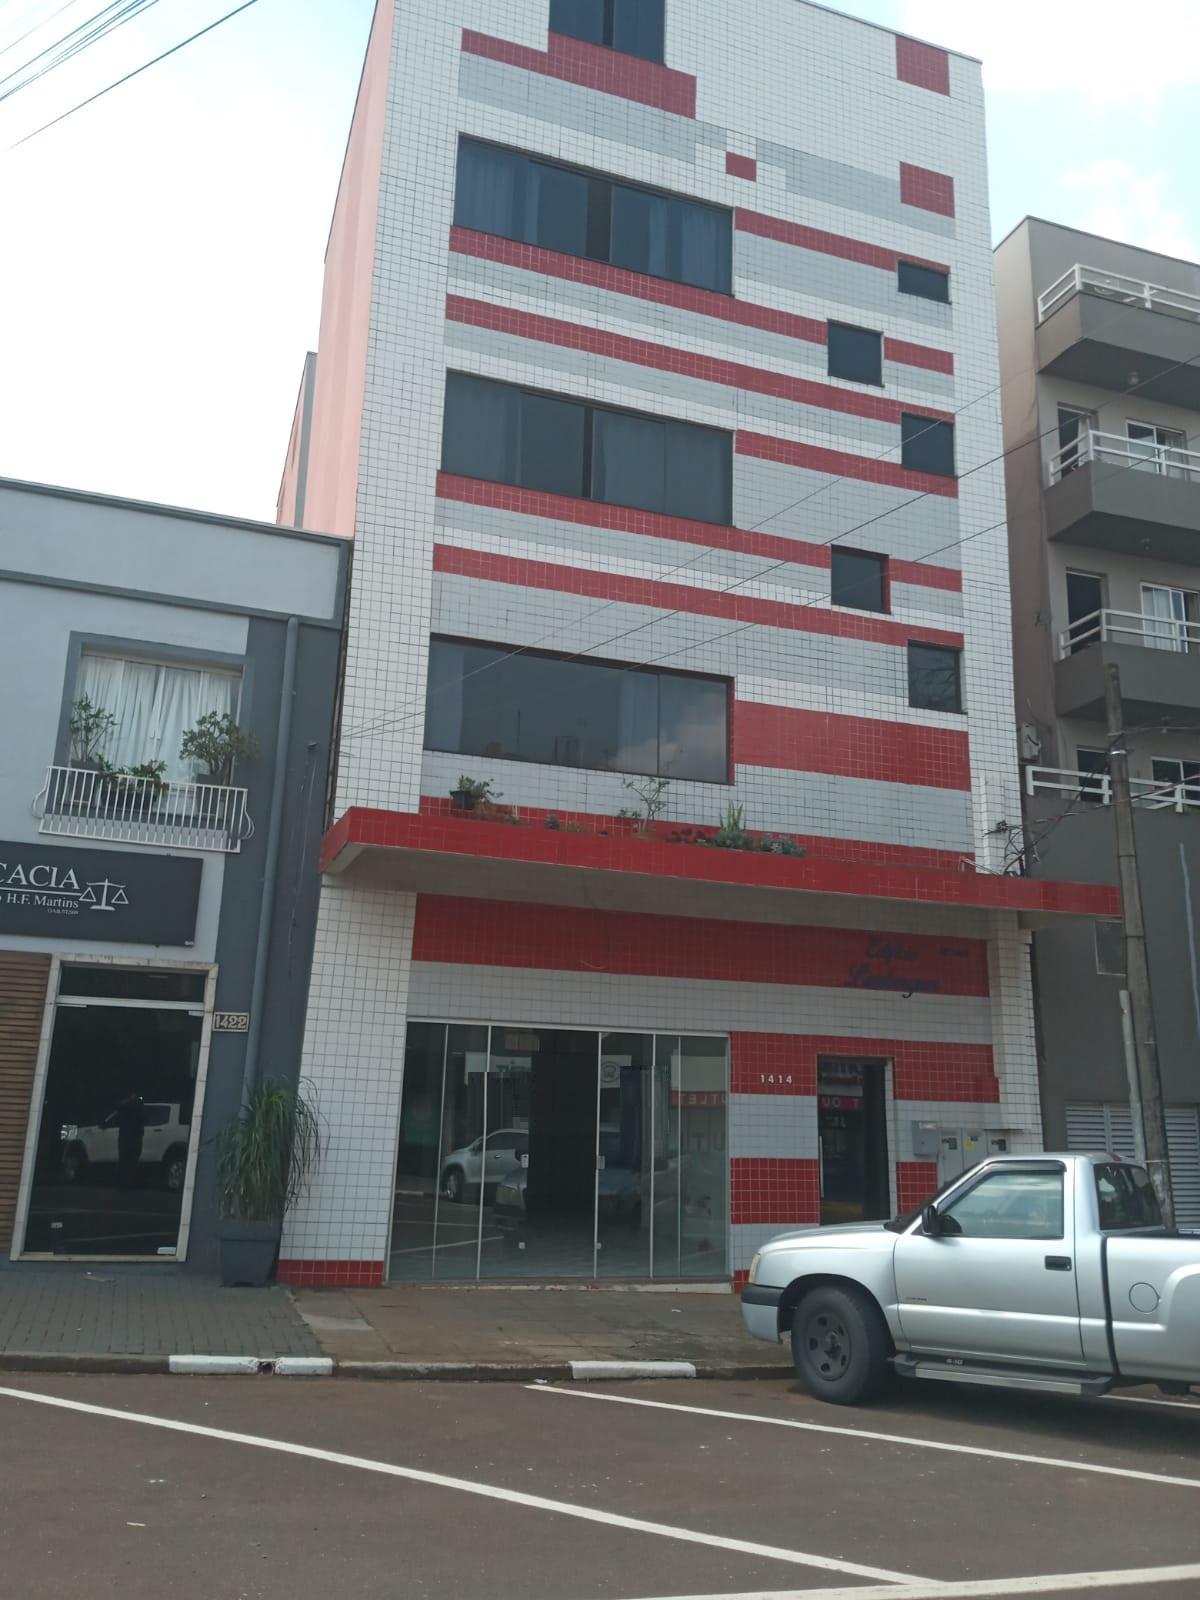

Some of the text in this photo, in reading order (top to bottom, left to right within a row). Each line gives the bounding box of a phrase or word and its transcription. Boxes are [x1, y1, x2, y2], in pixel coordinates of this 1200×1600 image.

[7, 893, 79, 908] H.F. Martins
[215, 1015, 247, 1029] 1422
[760, 1074, 793, 1084] 1414
